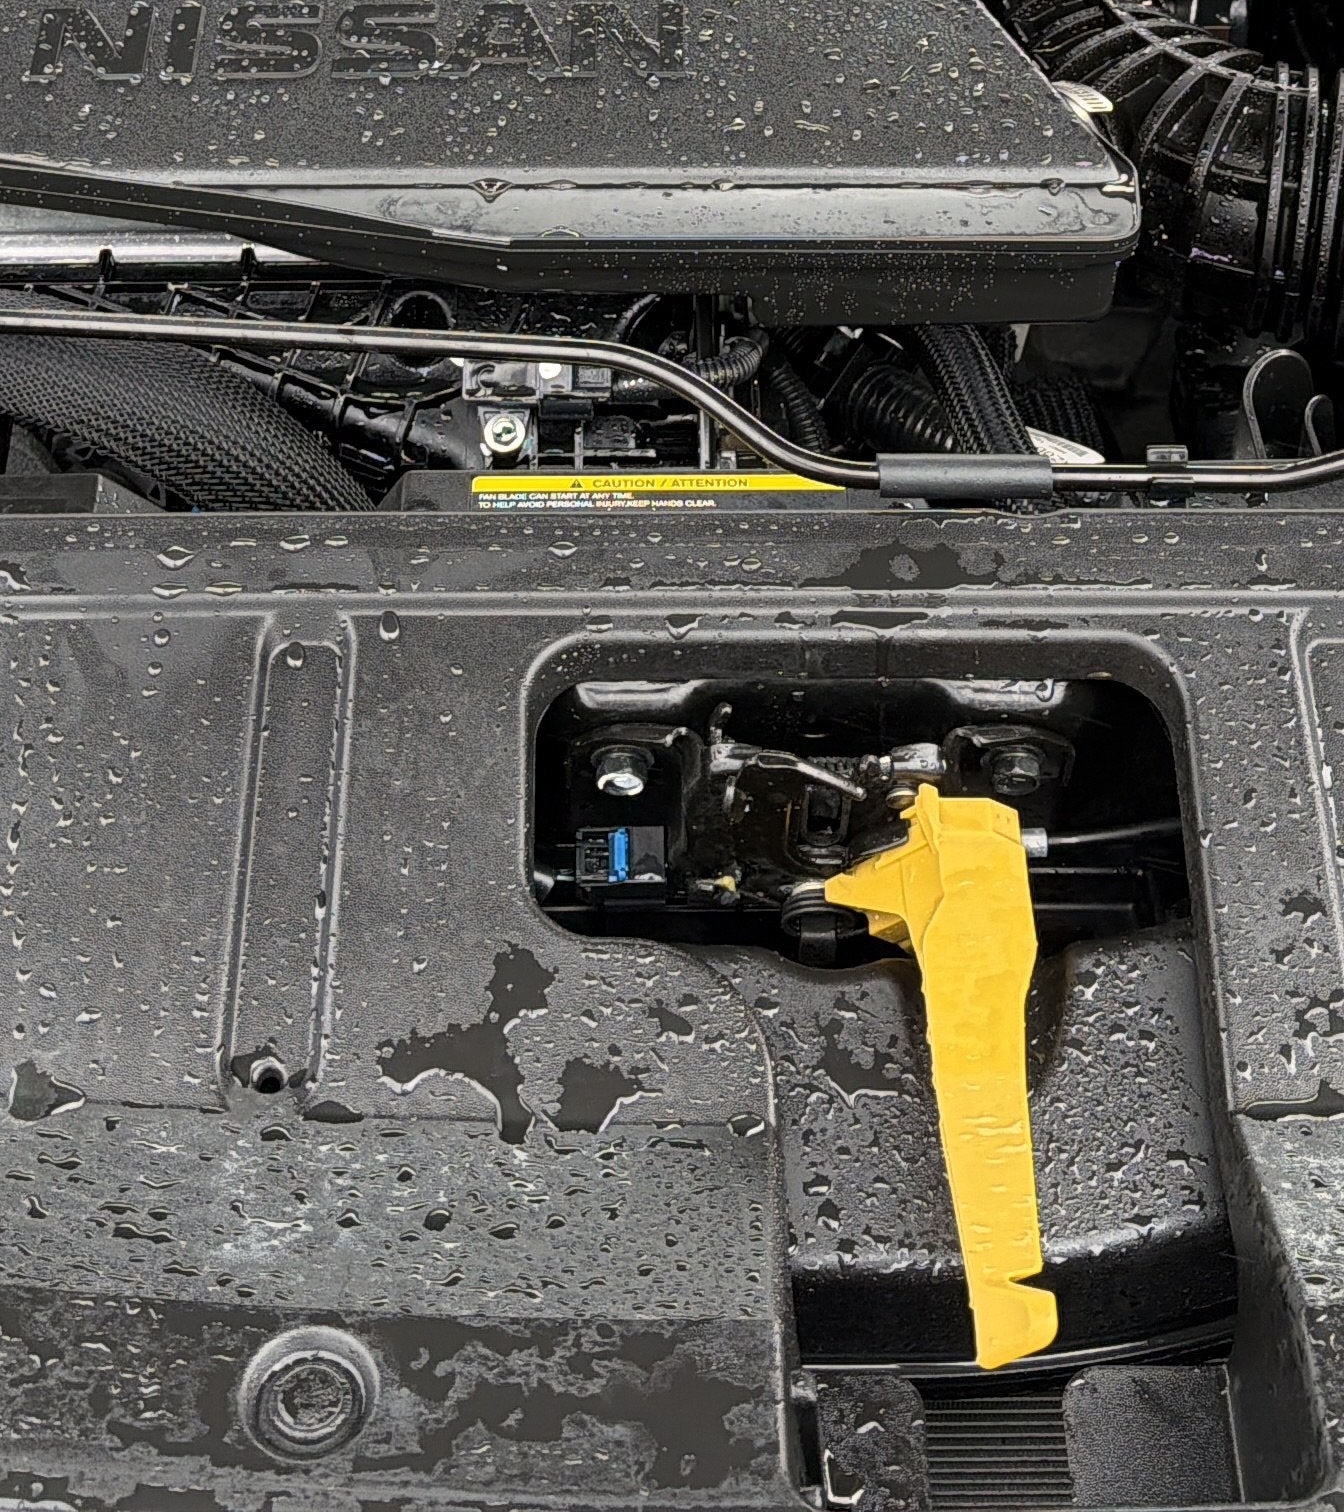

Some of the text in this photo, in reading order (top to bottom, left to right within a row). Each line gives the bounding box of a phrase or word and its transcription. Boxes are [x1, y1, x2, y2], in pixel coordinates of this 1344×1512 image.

[21, 2, 688, 80] NISSAN
[592, 478, 656, 489] CAUTION
[671, 477, 748, 488] ATTENTION
[479, 492, 496, 500] FAN
[498, 492, 527, 500] BLADE
[529, 492, 548, 500] CAN
[550, 492, 577, 500] START
[579, 492, 591, 500] AT
[592, 492, 610, 500] ANY
[479, 500, 490, 508] TO
[492, 500, 516, 508] HELP
[517, 500, 545, 508] AVOID
[546, 500, 594, 508] PERSONAL
[652, 500, 684, 508] HANDS
